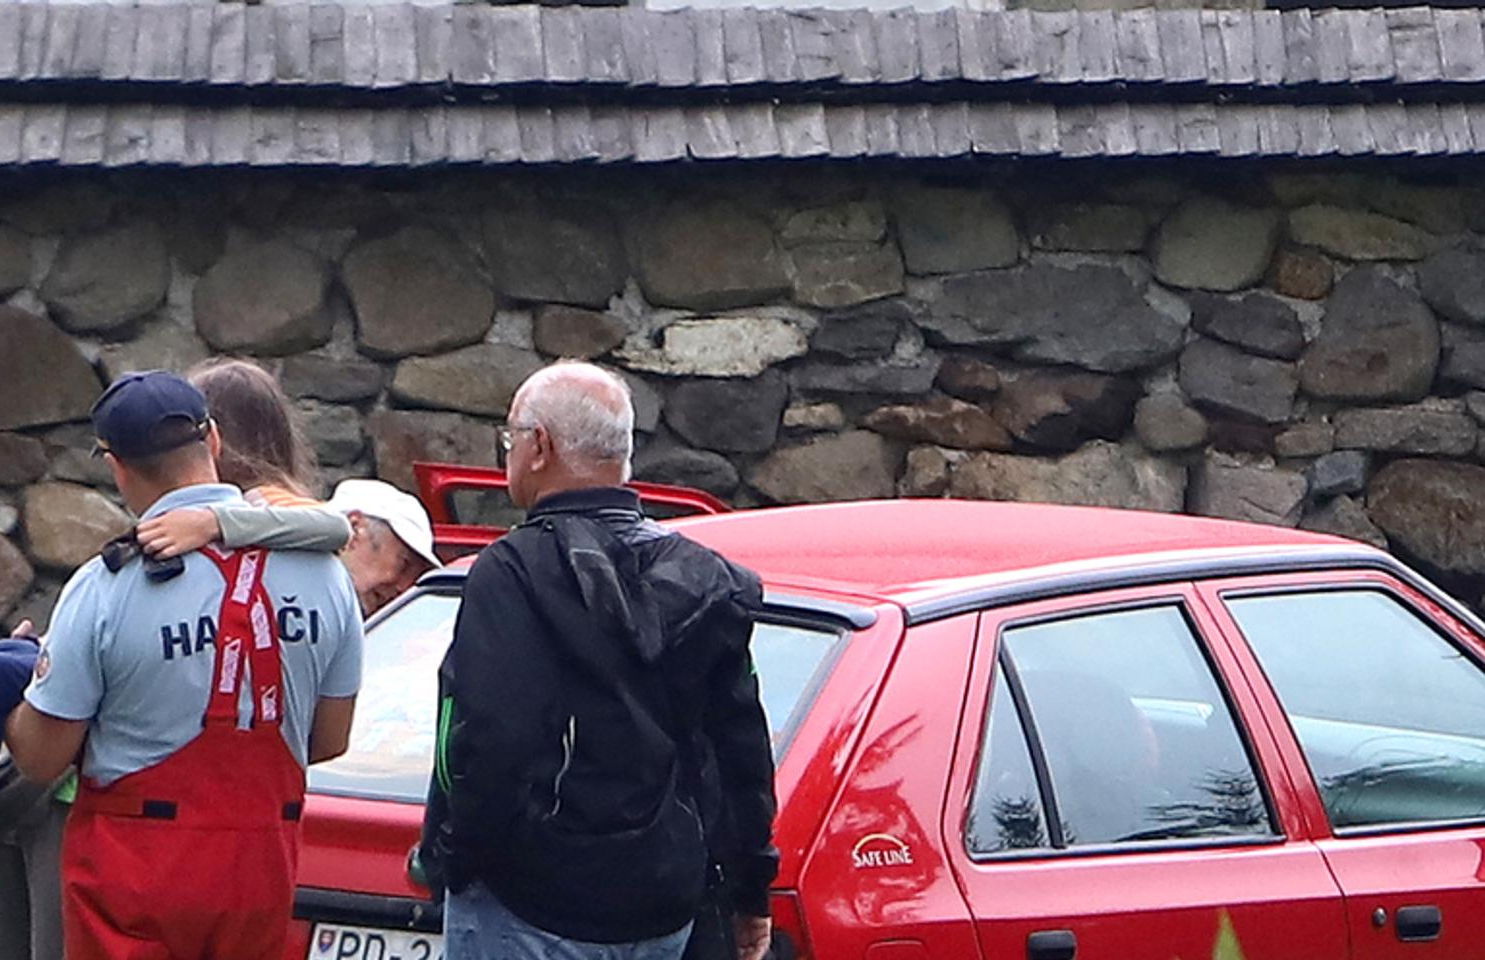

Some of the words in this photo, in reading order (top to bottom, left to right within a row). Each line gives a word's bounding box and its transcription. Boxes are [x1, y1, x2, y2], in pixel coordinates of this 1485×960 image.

[161, 594, 319, 661] HAČI
[852, 848, 883, 868] SAFE
[883, 845, 914, 865] LINE
